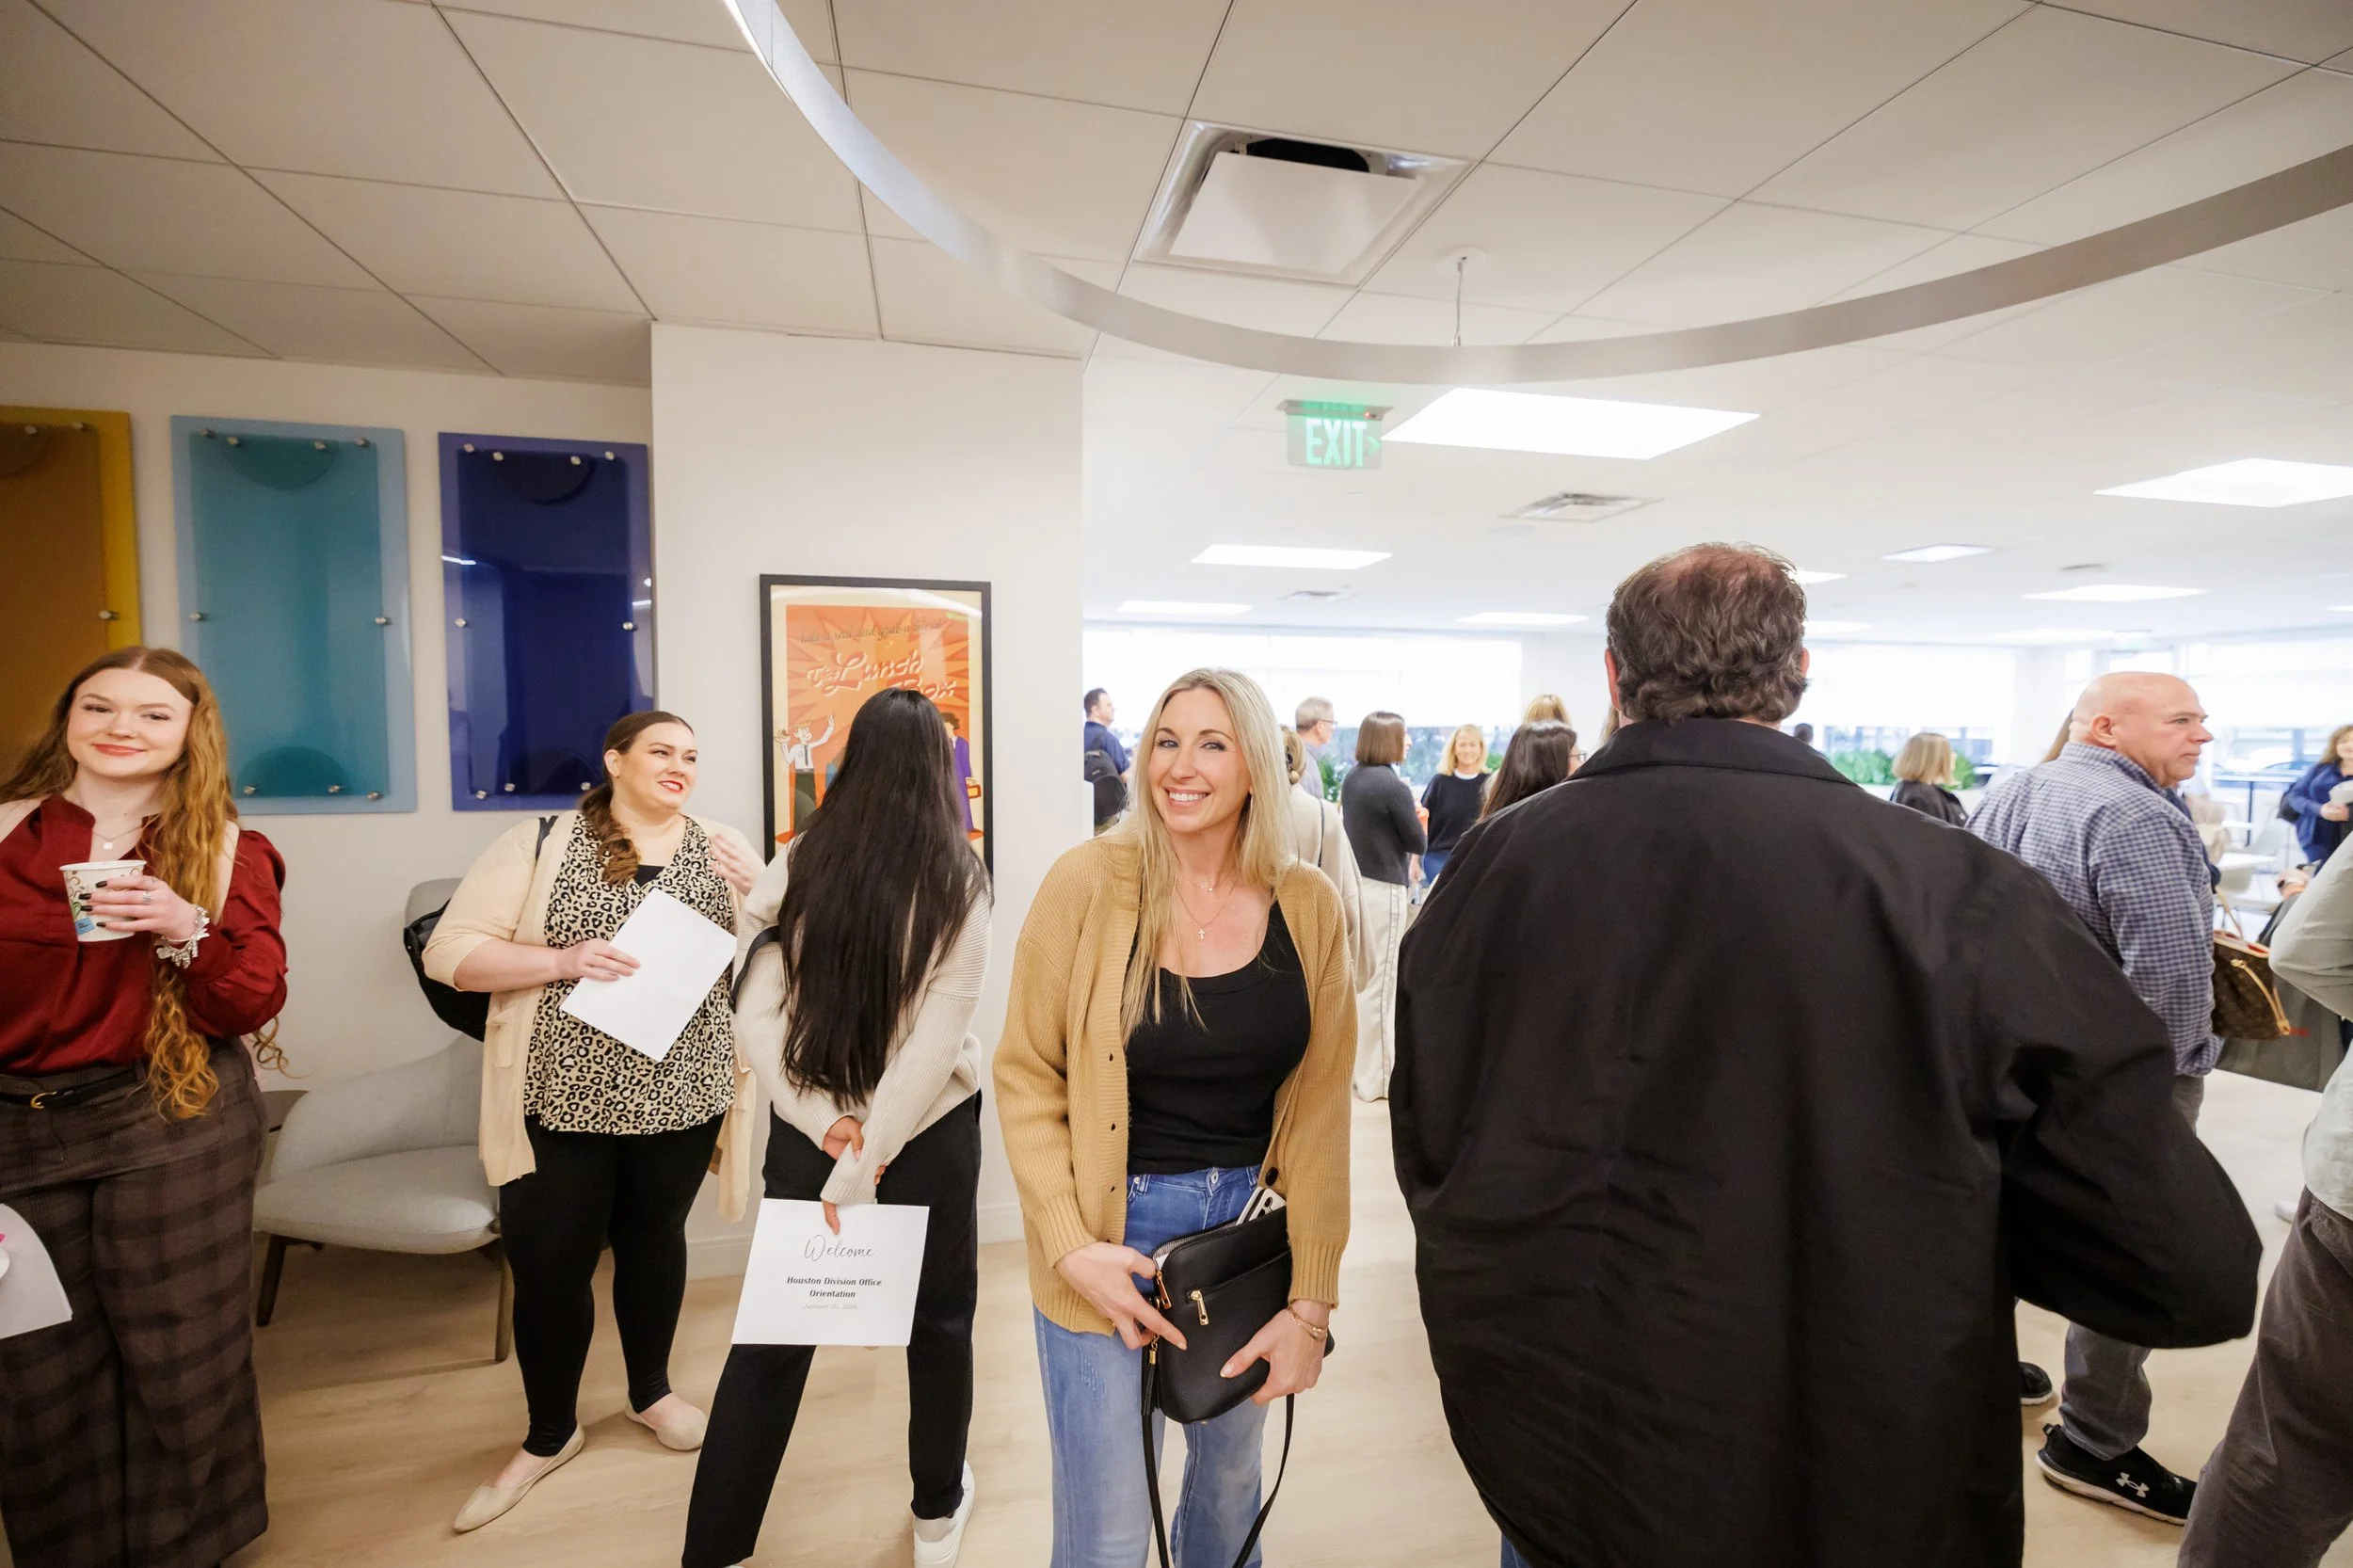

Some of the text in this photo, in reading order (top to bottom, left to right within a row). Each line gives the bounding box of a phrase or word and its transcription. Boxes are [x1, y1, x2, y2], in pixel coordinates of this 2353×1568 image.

[1305, 418, 1368, 467] EXIT
[855, 624, 875, 642] and
[824, 648, 923, 697] Lunch
[804, 1234, 874, 1262] Welcome
[786, 1276, 882, 1287] Houston Division Office
[809, 1289, 856, 1298] Orientation
